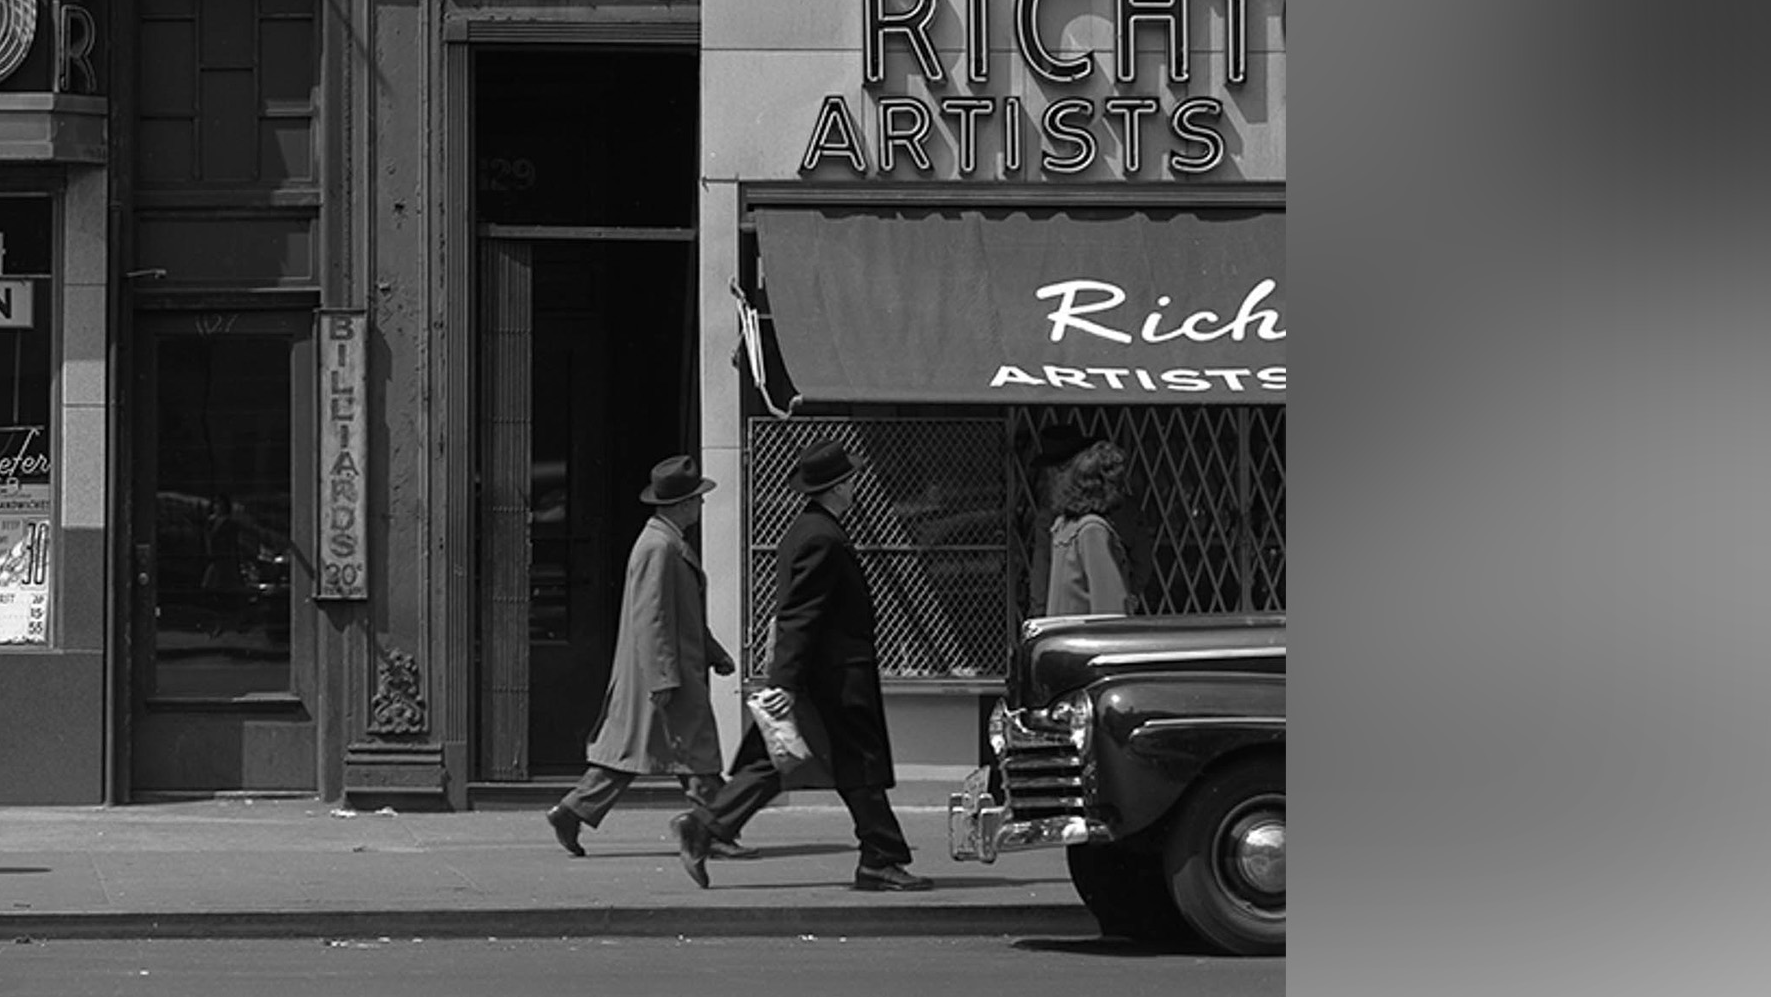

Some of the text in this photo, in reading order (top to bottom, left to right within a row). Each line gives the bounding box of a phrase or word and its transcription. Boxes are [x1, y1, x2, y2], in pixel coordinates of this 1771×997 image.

[798, 94, 1229, 178] ARTISTS
[1033, 277, 1286, 346] Rich
[988, 364, 1286, 395] ARTISTS
[329, 315, 359, 558] BILLIARDS
